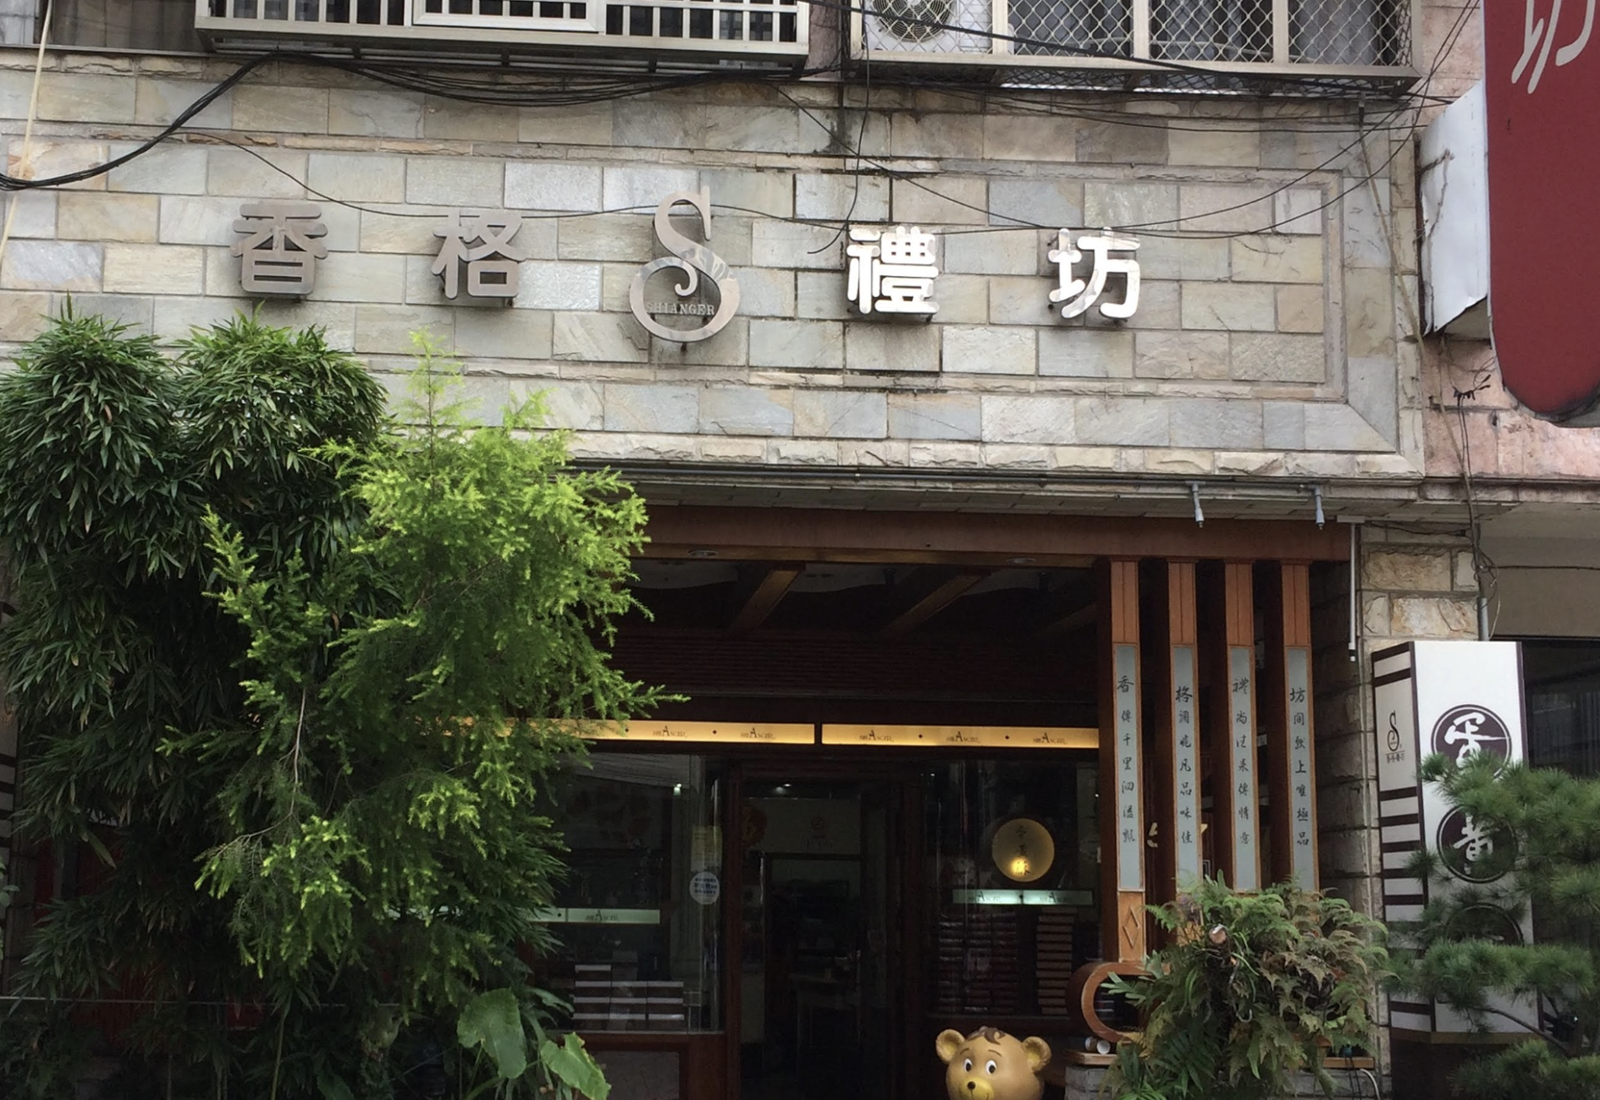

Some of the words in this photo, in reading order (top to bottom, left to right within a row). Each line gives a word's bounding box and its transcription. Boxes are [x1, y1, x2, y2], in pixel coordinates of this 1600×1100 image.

[229, 200, 527, 299] 香格
[846, 226, 1141, 319] 禮坊
[645, 302, 716, 316] SHIANGER
